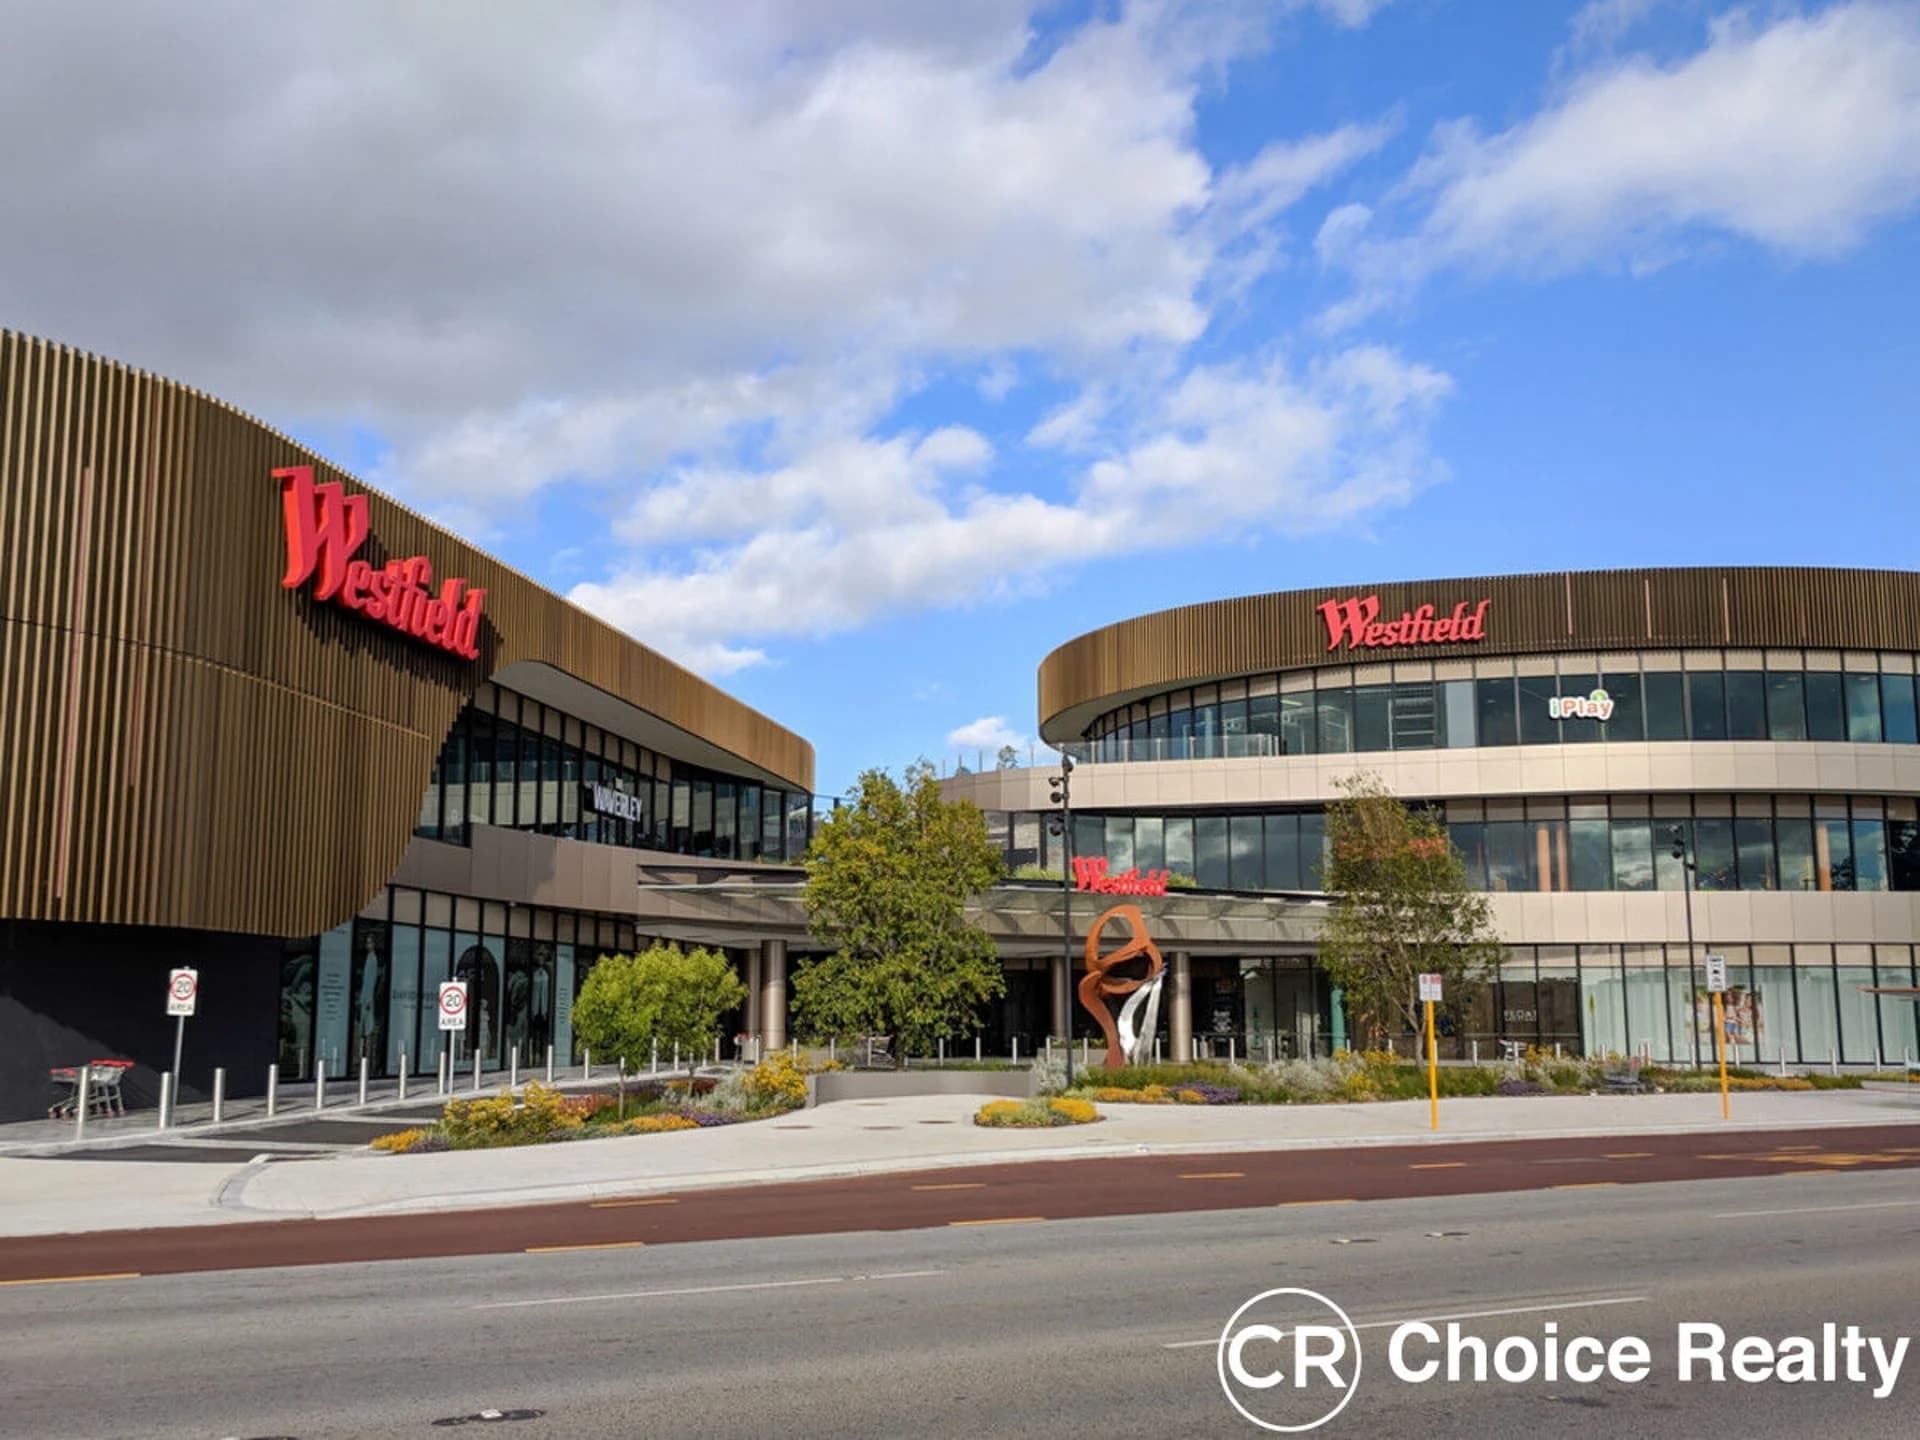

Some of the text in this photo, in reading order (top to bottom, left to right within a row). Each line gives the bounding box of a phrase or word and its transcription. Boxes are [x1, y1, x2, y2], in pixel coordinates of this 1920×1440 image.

[271, 464, 489, 661] Westfield
[1316, 594, 1491, 651] Westfield
[1072, 856, 1171, 896] Westfield
[176, 980, 192, 994] 20
[445, 994, 461, 1007] 20
